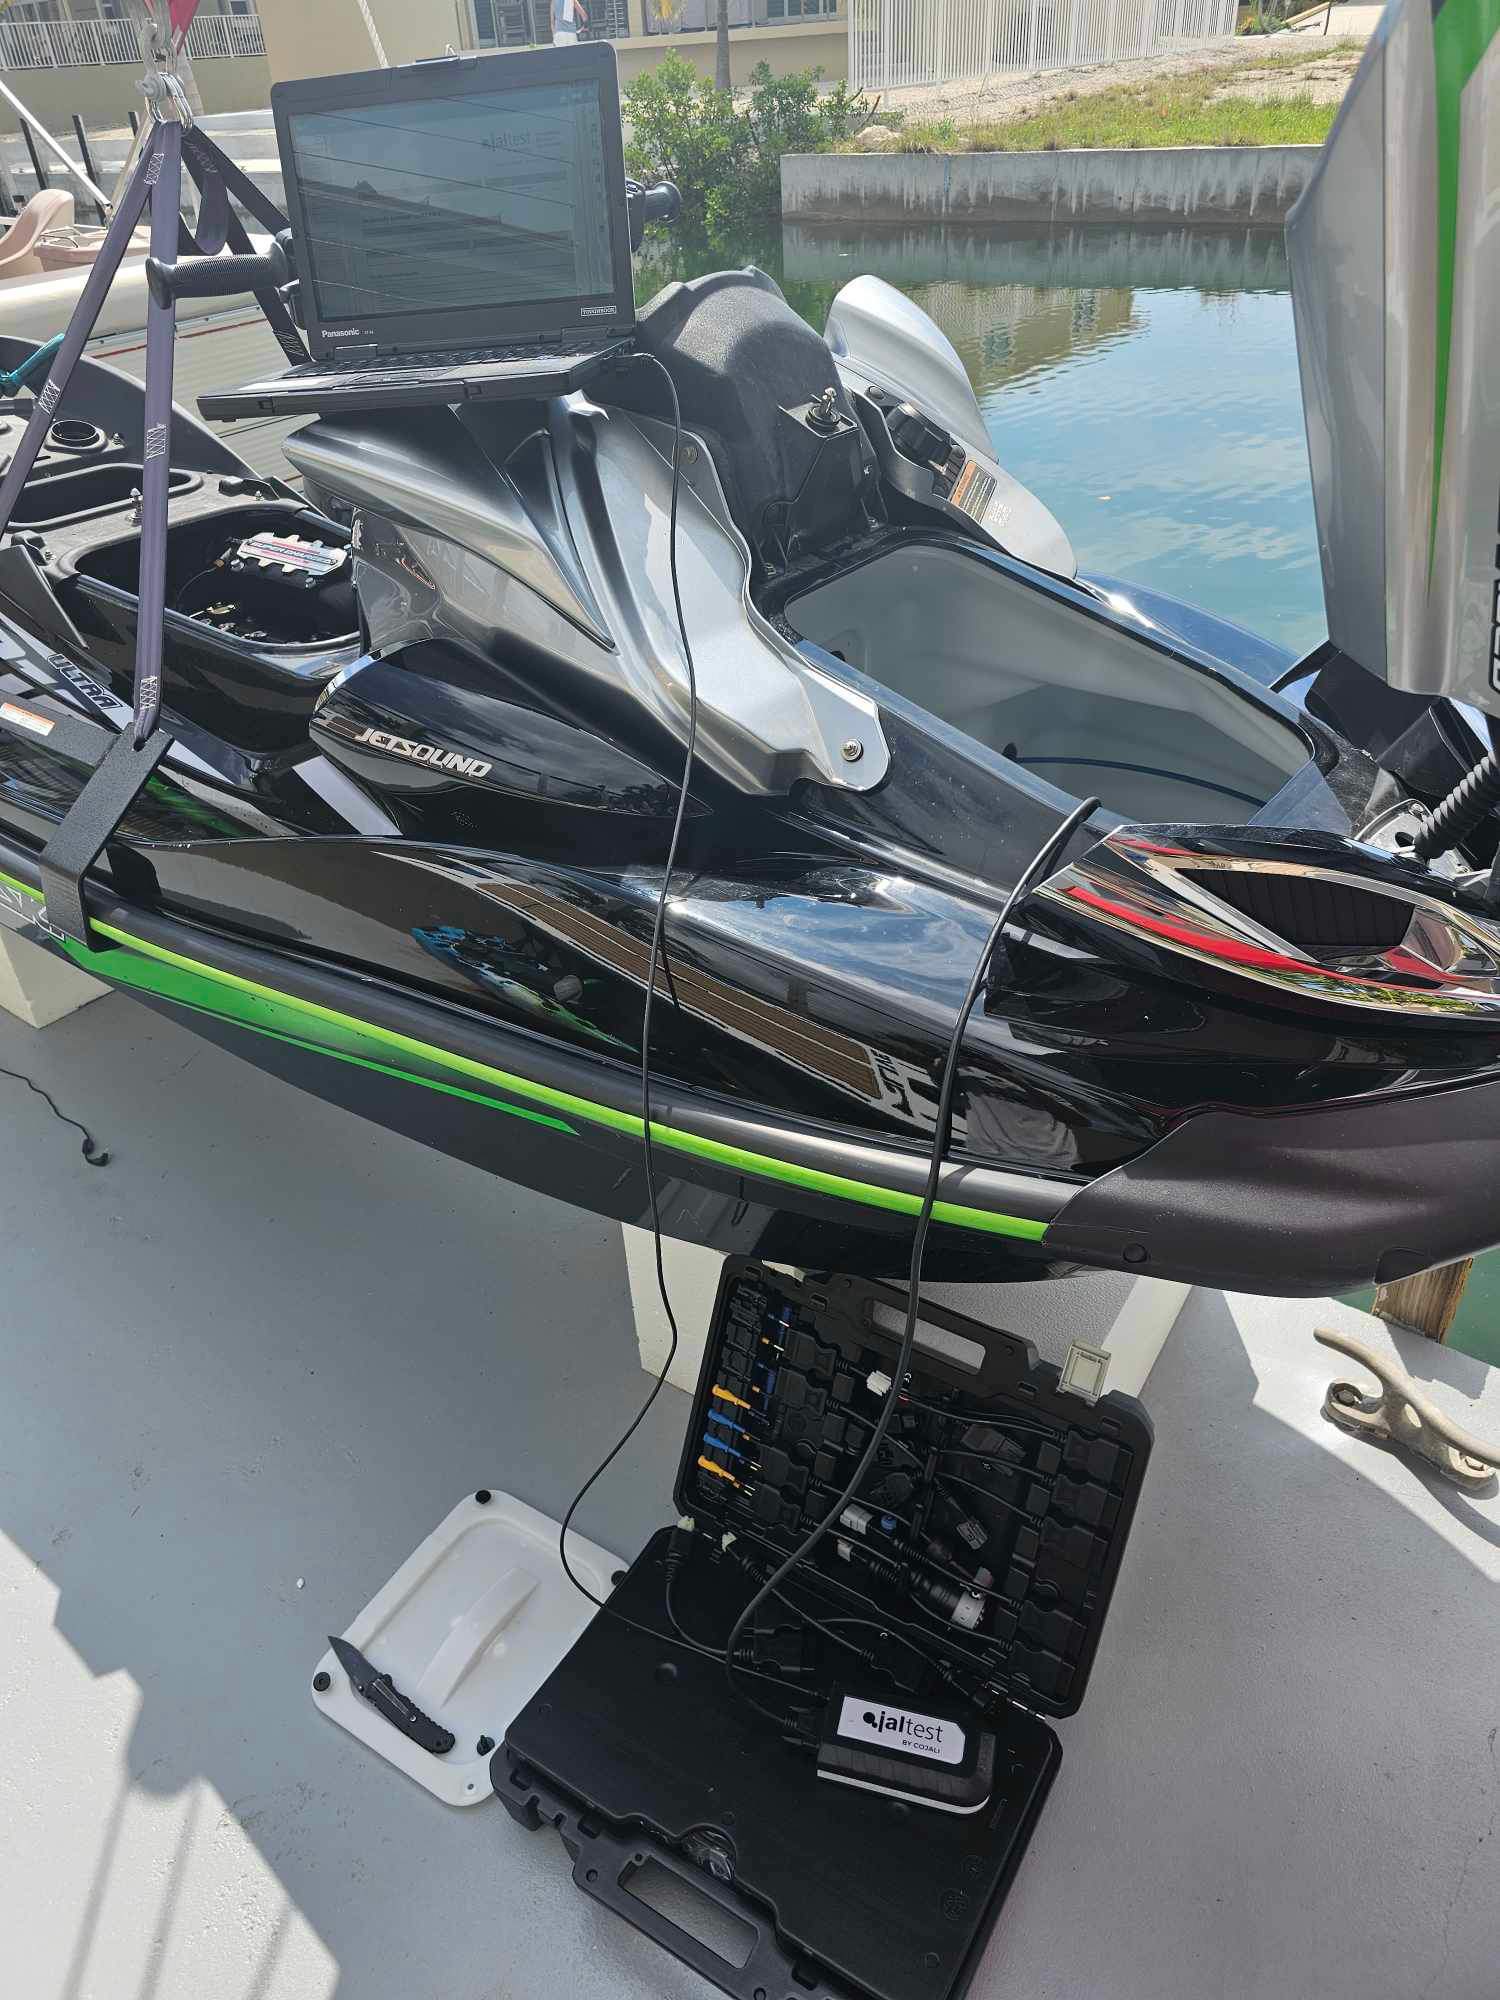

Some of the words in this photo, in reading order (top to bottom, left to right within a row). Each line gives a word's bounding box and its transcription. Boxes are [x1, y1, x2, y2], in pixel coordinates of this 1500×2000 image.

[321, 328, 360, 338] Panasonic
[48, 654, 122, 709] ULTRA
[354, 727, 493, 778] JETSOUND
[878, 1711, 943, 1743] jaltest
[913, 1742, 940, 1754] COJALI
